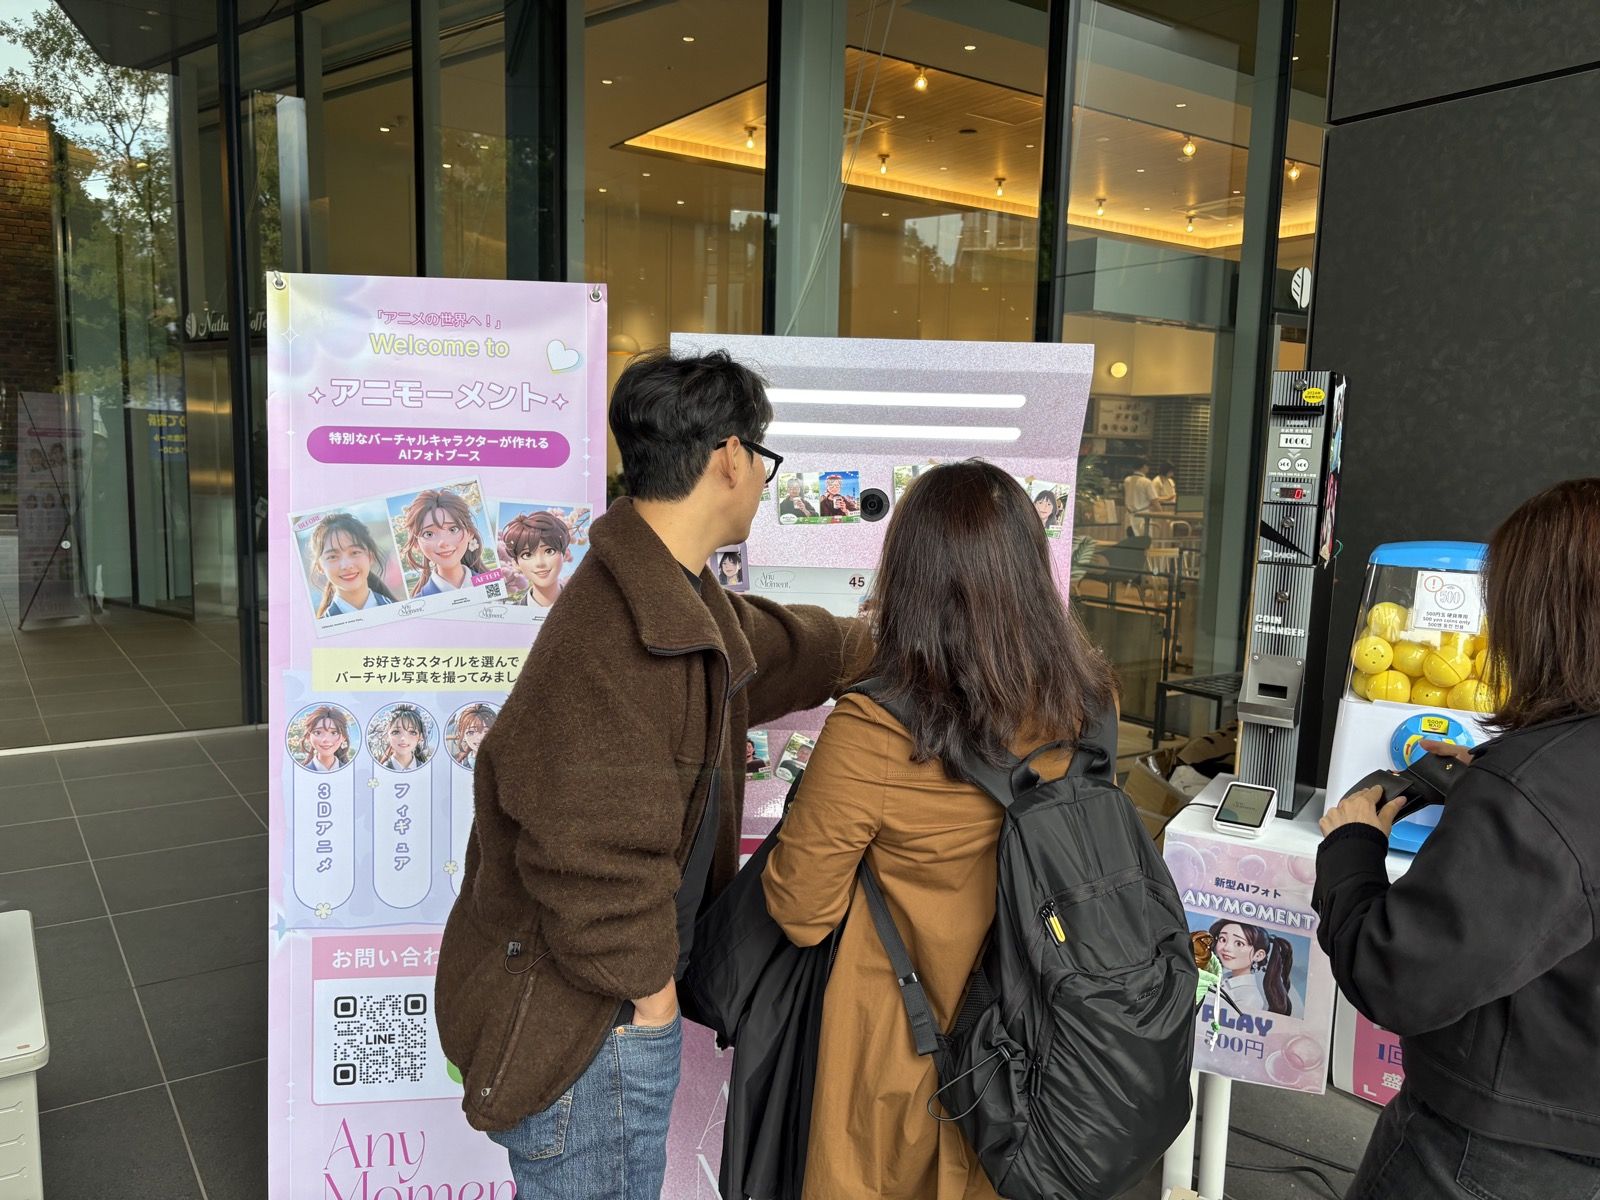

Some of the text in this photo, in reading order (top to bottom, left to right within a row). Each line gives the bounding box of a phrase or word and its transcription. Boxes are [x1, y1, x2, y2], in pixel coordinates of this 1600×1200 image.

[369, 333, 510, 358] Welcome to
[330, 378, 548, 412] アニモーメント
[328, 431, 549, 450] 特別なバーチャルキャラクターが作れる
[398, 449, 480, 462] AIフォトブース
[475, 571, 501, 584] AFTER
[849, 577, 865, 588] 45
[1439, 590, 1461, 604] 500
[1255, 614, 1282, 625] COIN
[1254, 625, 1305, 638] CHANGER
[362, 656, 520, 669] お好きなスタイルを選んで
[336, 671, 517, 684] バーチャル写真を撮ってみまし
[316, 782, 333, 873] 3Dアニメ
[394, 783, 411, 872] フィギュア
[1214, 877, 1281, 899] 新型AIフォト
[1183, 889, 1315, 930] ANYMOMENT
[1201, 1004, 1273, 1037] PLAY
[365, 1034, 396, 1045] LINE
[323, 1117, 426, 1184] Any
